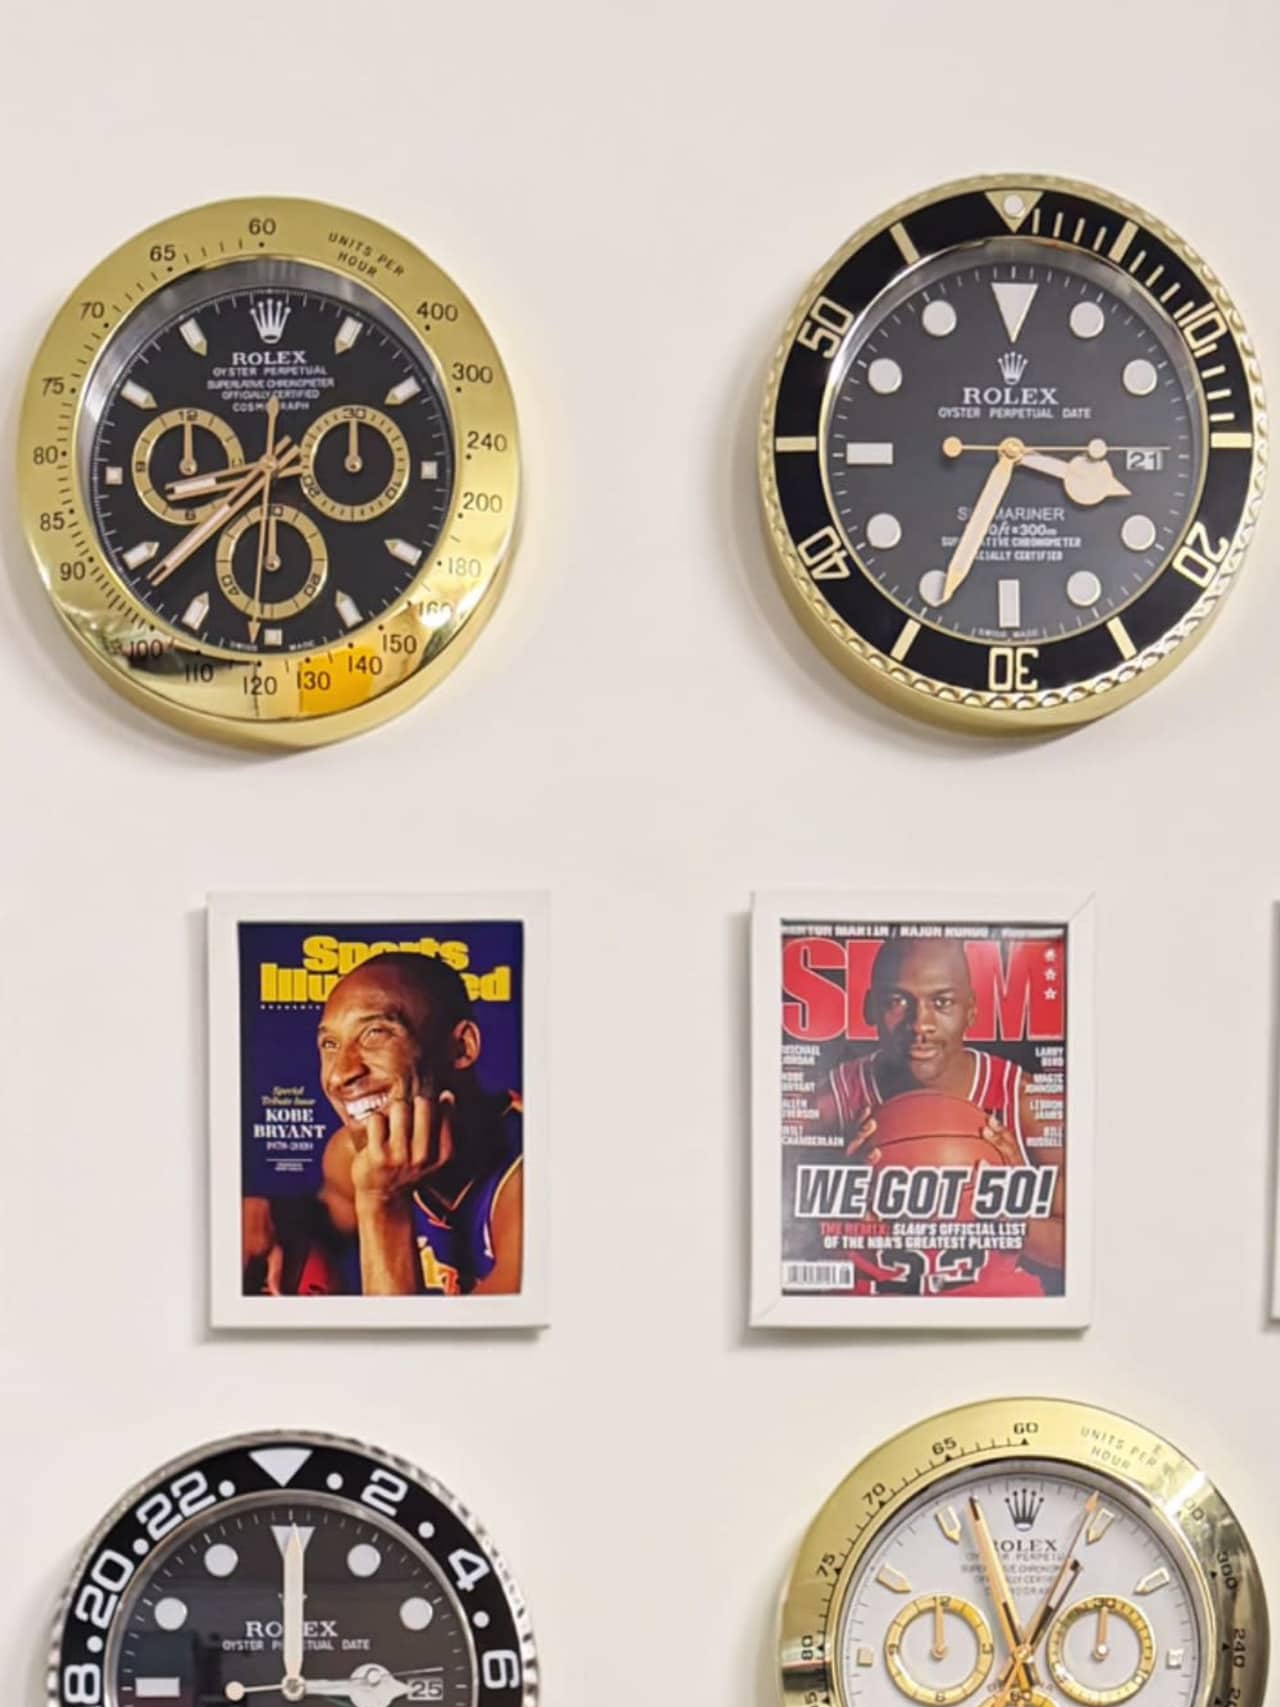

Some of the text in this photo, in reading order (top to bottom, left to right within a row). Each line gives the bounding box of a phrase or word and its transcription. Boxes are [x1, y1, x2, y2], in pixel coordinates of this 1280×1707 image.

[248, 219, 277, 236] 60
[149, 244, 177, 262] 65
[328, 232, 406, 279] UNITS PER
[337, 251, 379, 279] HOUR
[80, 302, 105, 320] 70
[416, 302, 458, 321] 400
[799, 300, 853, 358] 50
[1178, 301, 1228, 350] 10
[232, 351, 307, 366] ROLEX
[451, 365, 493, 384] 300
[963, 388, 1058, 405] ROLEX
[938, 407, 1091, 418] OYSTER PERPETUAL DATE
[467, 434, 508, 453] 240
[1130, 451, 1161, 470] 21
[462, 494, 503, 513] 200
[1173, 523, 1229, 587] 20
[243, 676, 278, 696] 120
[782, 937, 1063, 1041] SLM
[266, 1108, 314, 1122] KOBE
[253, 1124, 326, 1139] BRYANT
[796, 1165, 1058, 1218] WE GOT 50!
[999, 1222, 1026, 1235] LIST
[824, 1237, 840, 1249] OF
[843, 1236, 865, 1249] THE
[1014, 1421, 1038, 1434] 60
[930, 1437, 957, 1455] 65
[138, 1471, 215, 1538] 22
[863, 1484, 886, 1506] 70
[245, 1621, 338, 1637] ROEX
[410, 1681, 442, 1698] 25
